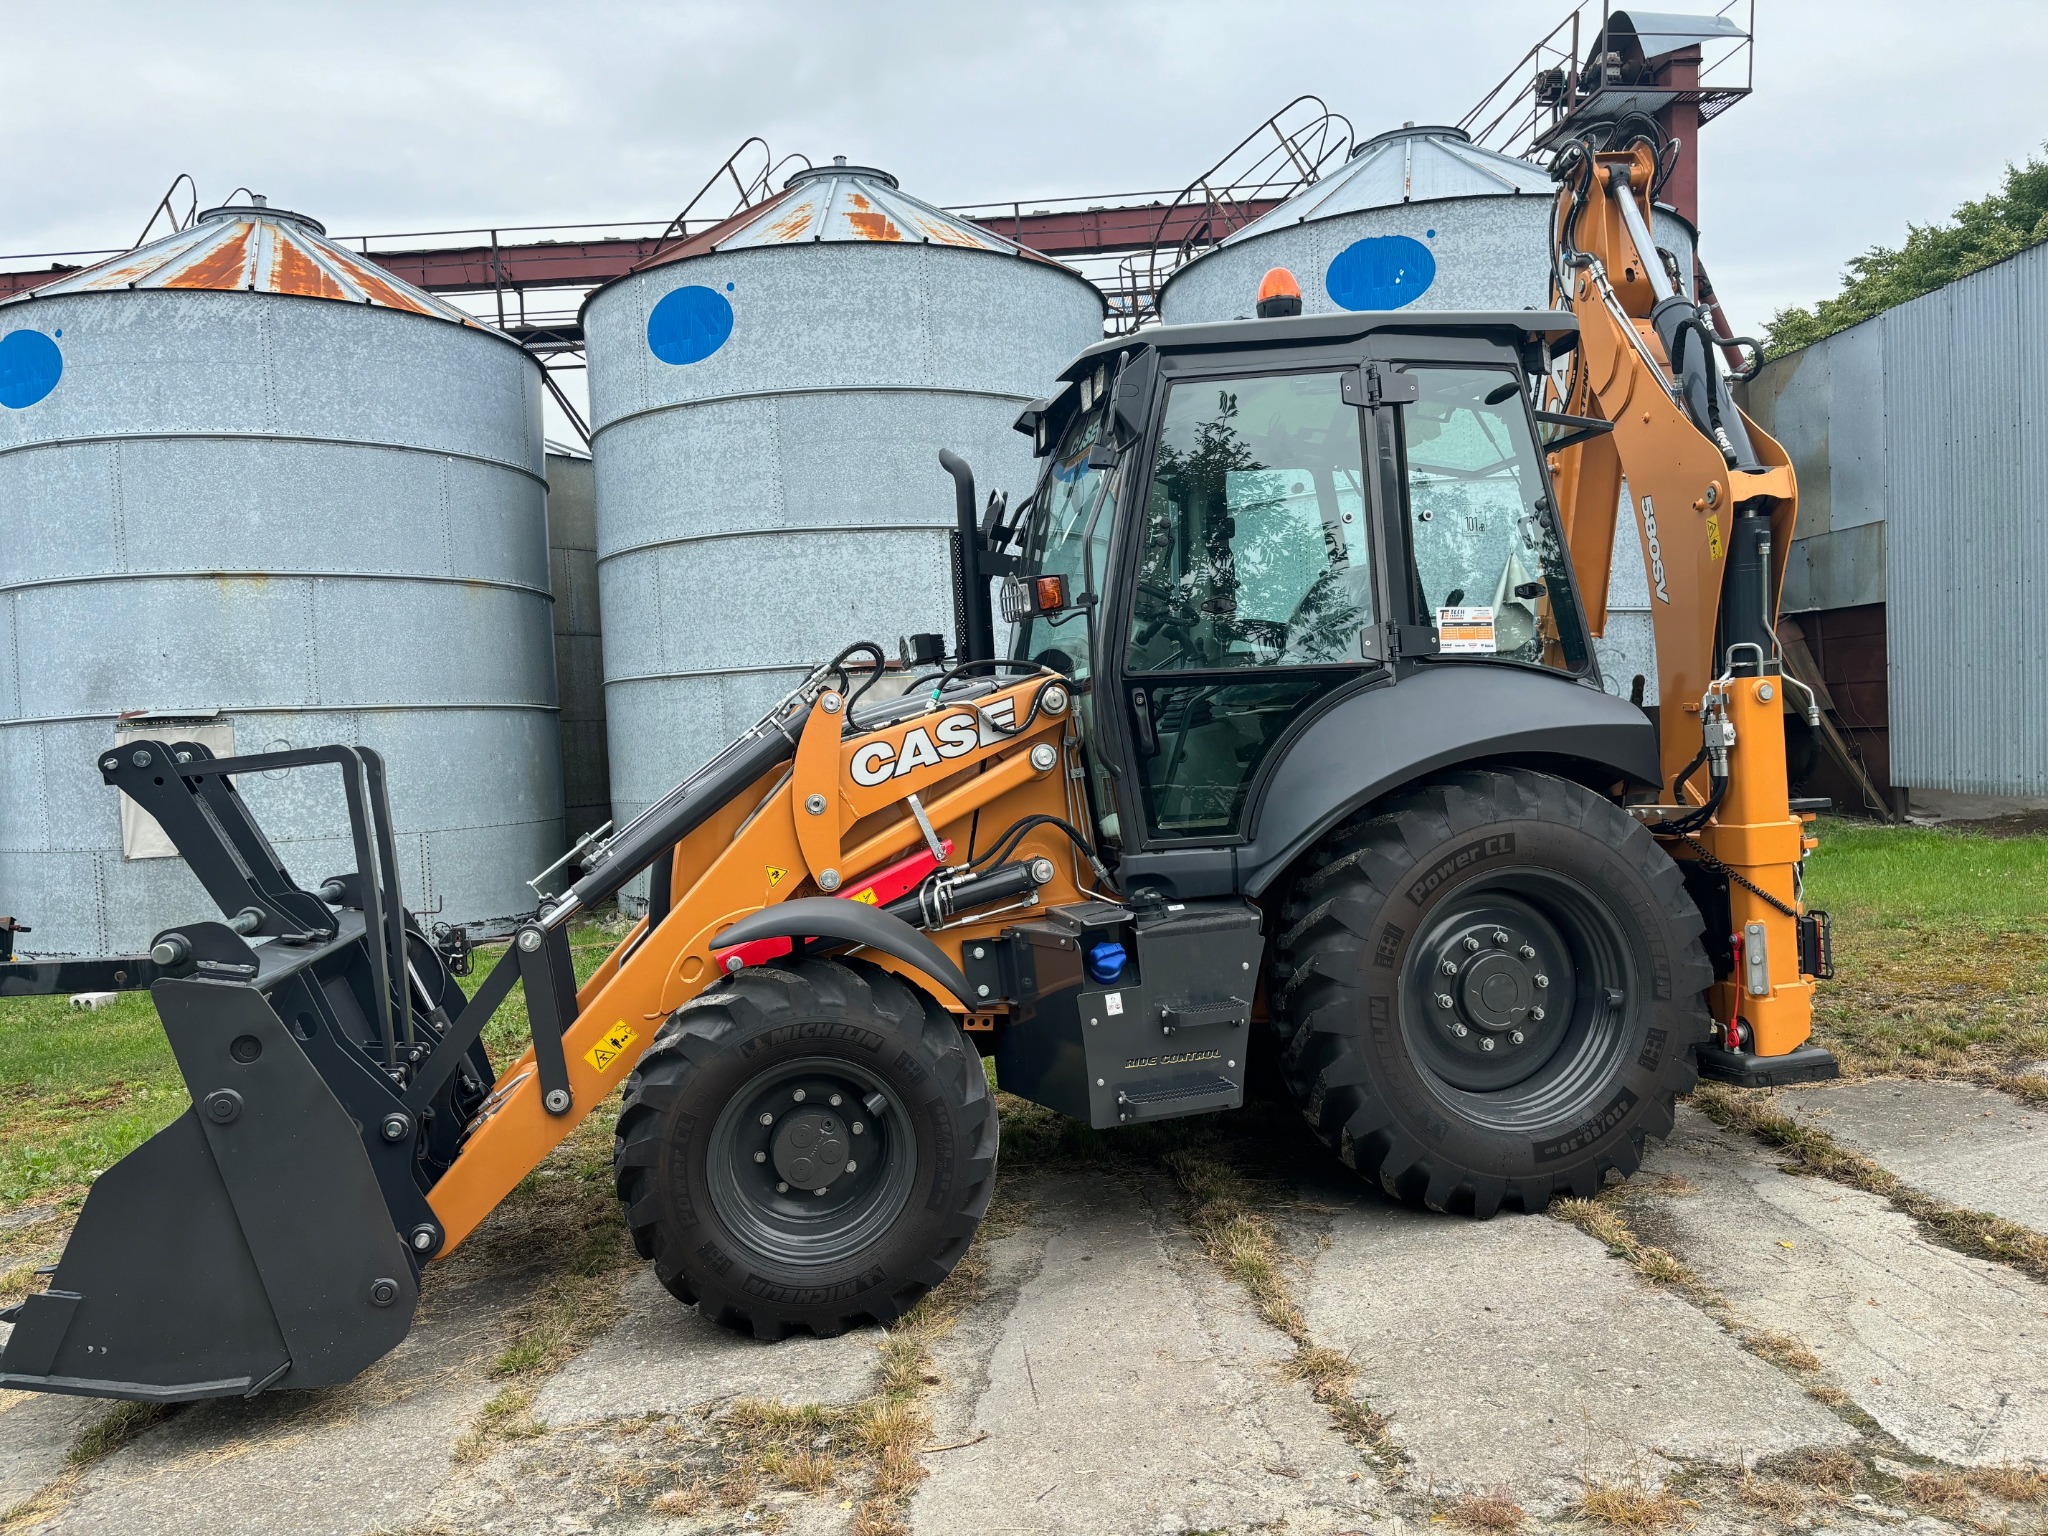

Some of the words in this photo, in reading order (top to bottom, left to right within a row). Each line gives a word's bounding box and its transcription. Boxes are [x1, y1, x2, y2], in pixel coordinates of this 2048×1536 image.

[1465, 516, 1478, 531] 101
[1641, 494, 1670, 605] 580SV
[850, 696, 1017, 787] CASE
[1410, 846, 1480, 904] Power
[1484, 836, 1511, 856] CL
[771, 1021, 885, 1050] MICHELIN
[1124, 1056, 1158, 1069] RIDE
[1160, 1049, 1222, 1065] CONTROL
[673, 1148, 698, 1226] Power
[745, 1278, 858, 1304] MICHELIN
